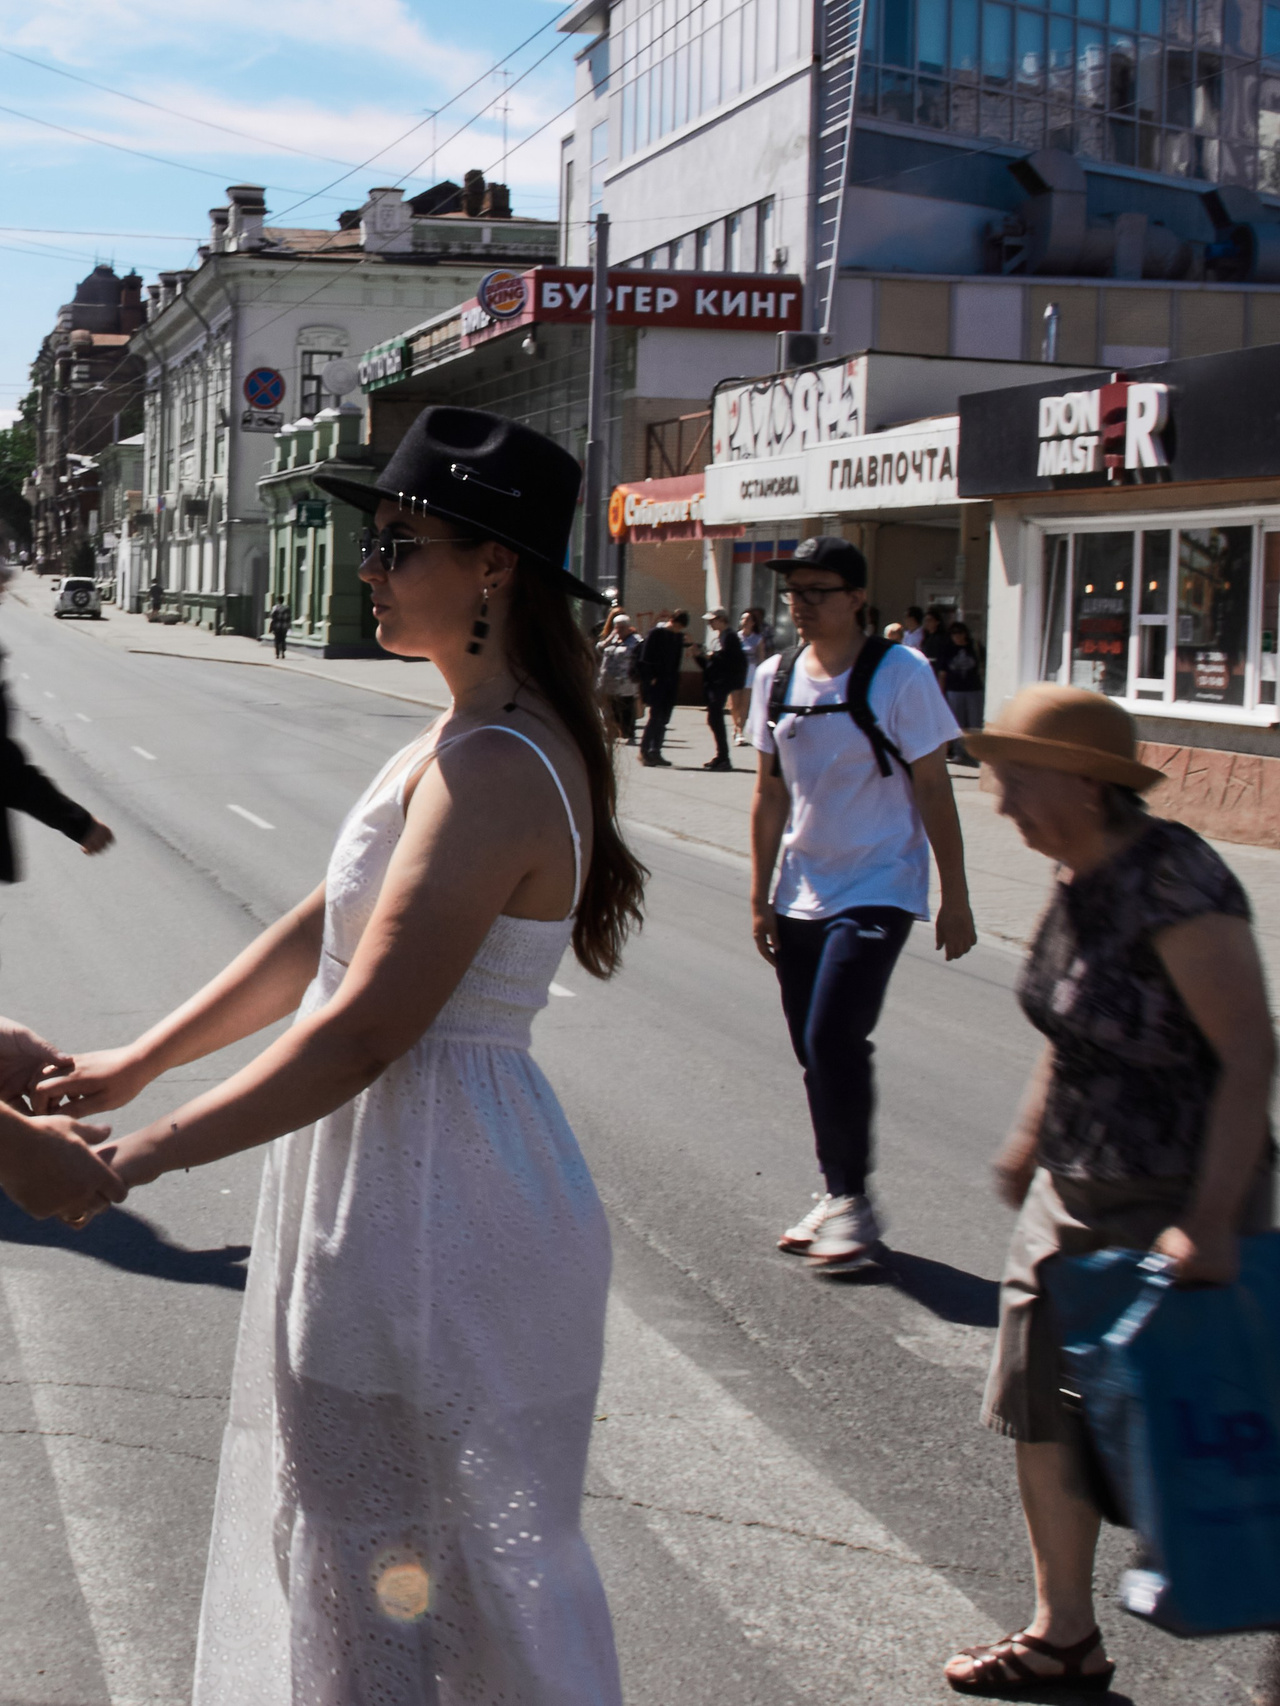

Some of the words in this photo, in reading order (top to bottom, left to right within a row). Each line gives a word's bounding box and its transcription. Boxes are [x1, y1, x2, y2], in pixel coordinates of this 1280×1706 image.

[487, 286, 524, 305] KING
[695, 289, 797, 319] КИНГ
[1038, 389, 1101, 438] DON
[829, 446, 956, 491] ГЛАВПОЧТА
[740, 475, 800, 500] ОСТАНОВКА
